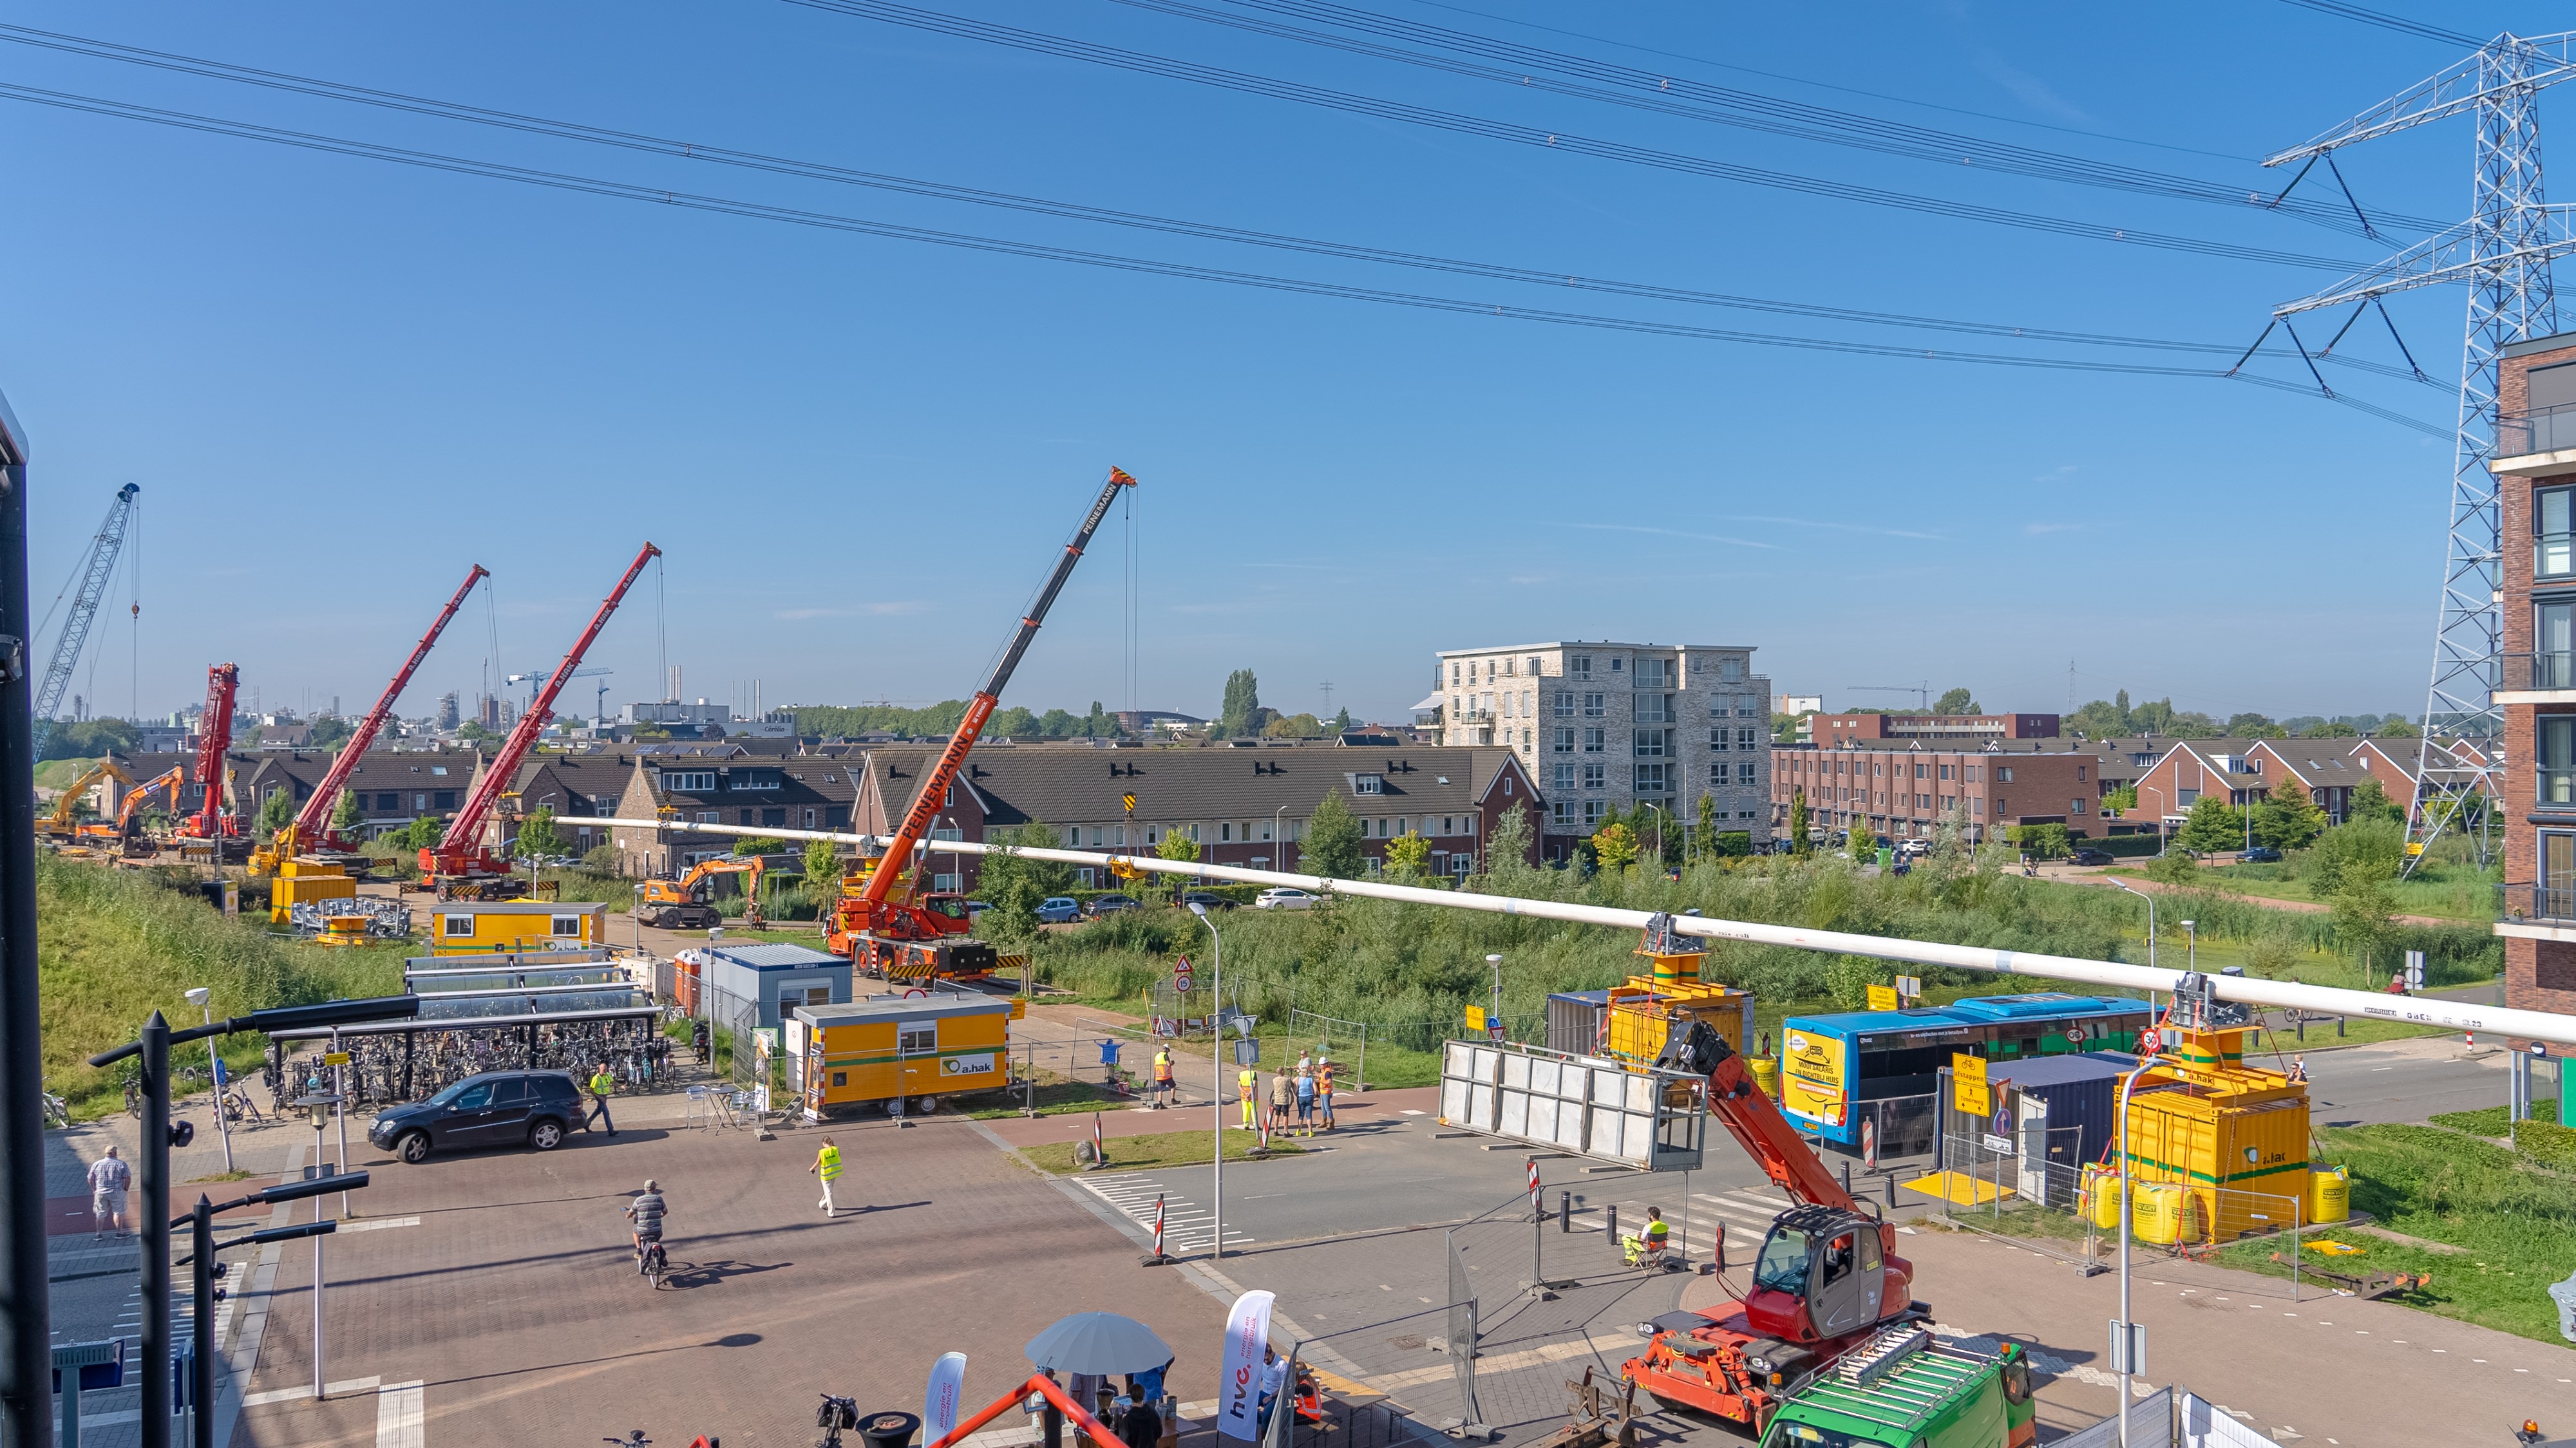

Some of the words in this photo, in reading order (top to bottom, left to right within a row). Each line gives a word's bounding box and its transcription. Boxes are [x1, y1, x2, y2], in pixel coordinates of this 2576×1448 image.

[1083, 484, 1117, 535] PEINEMANN
[622, 566, 639, 589] A.HAK
[435, 612, 451, 633] A.HAK
[594, 607, 612, 630] A.HAK
[408, 648, 426, 671] A.HAK
[554, 661, 574, 688] A.HAK
[975, 701, 989, 718] TEREX
[902, 735, 969, 840] PEINEMANN
[962, 1063, 991, 1073] a.hak
[1803, 1071, 1825, 1080] DICHTBIJ
[1826, 1075, 1839, 1084] HUIS
[1813, 1065, 1833, 1074] SALARIS
[1955, 1071, 1984, 1082] afstappen
[2189, 1073, 2213, 1084] a.hak
[1960, 1095, 1984, 1106] Tenorweg
[1241, 1328, 1249, 1357] energie
[1245, 1316, 1250, 1326] en
[1245, 1317, 1256, 1359] hergebruik
[942, 1382, 947, 1393] en
[944, 1384, 952, 1431] hergebruik
